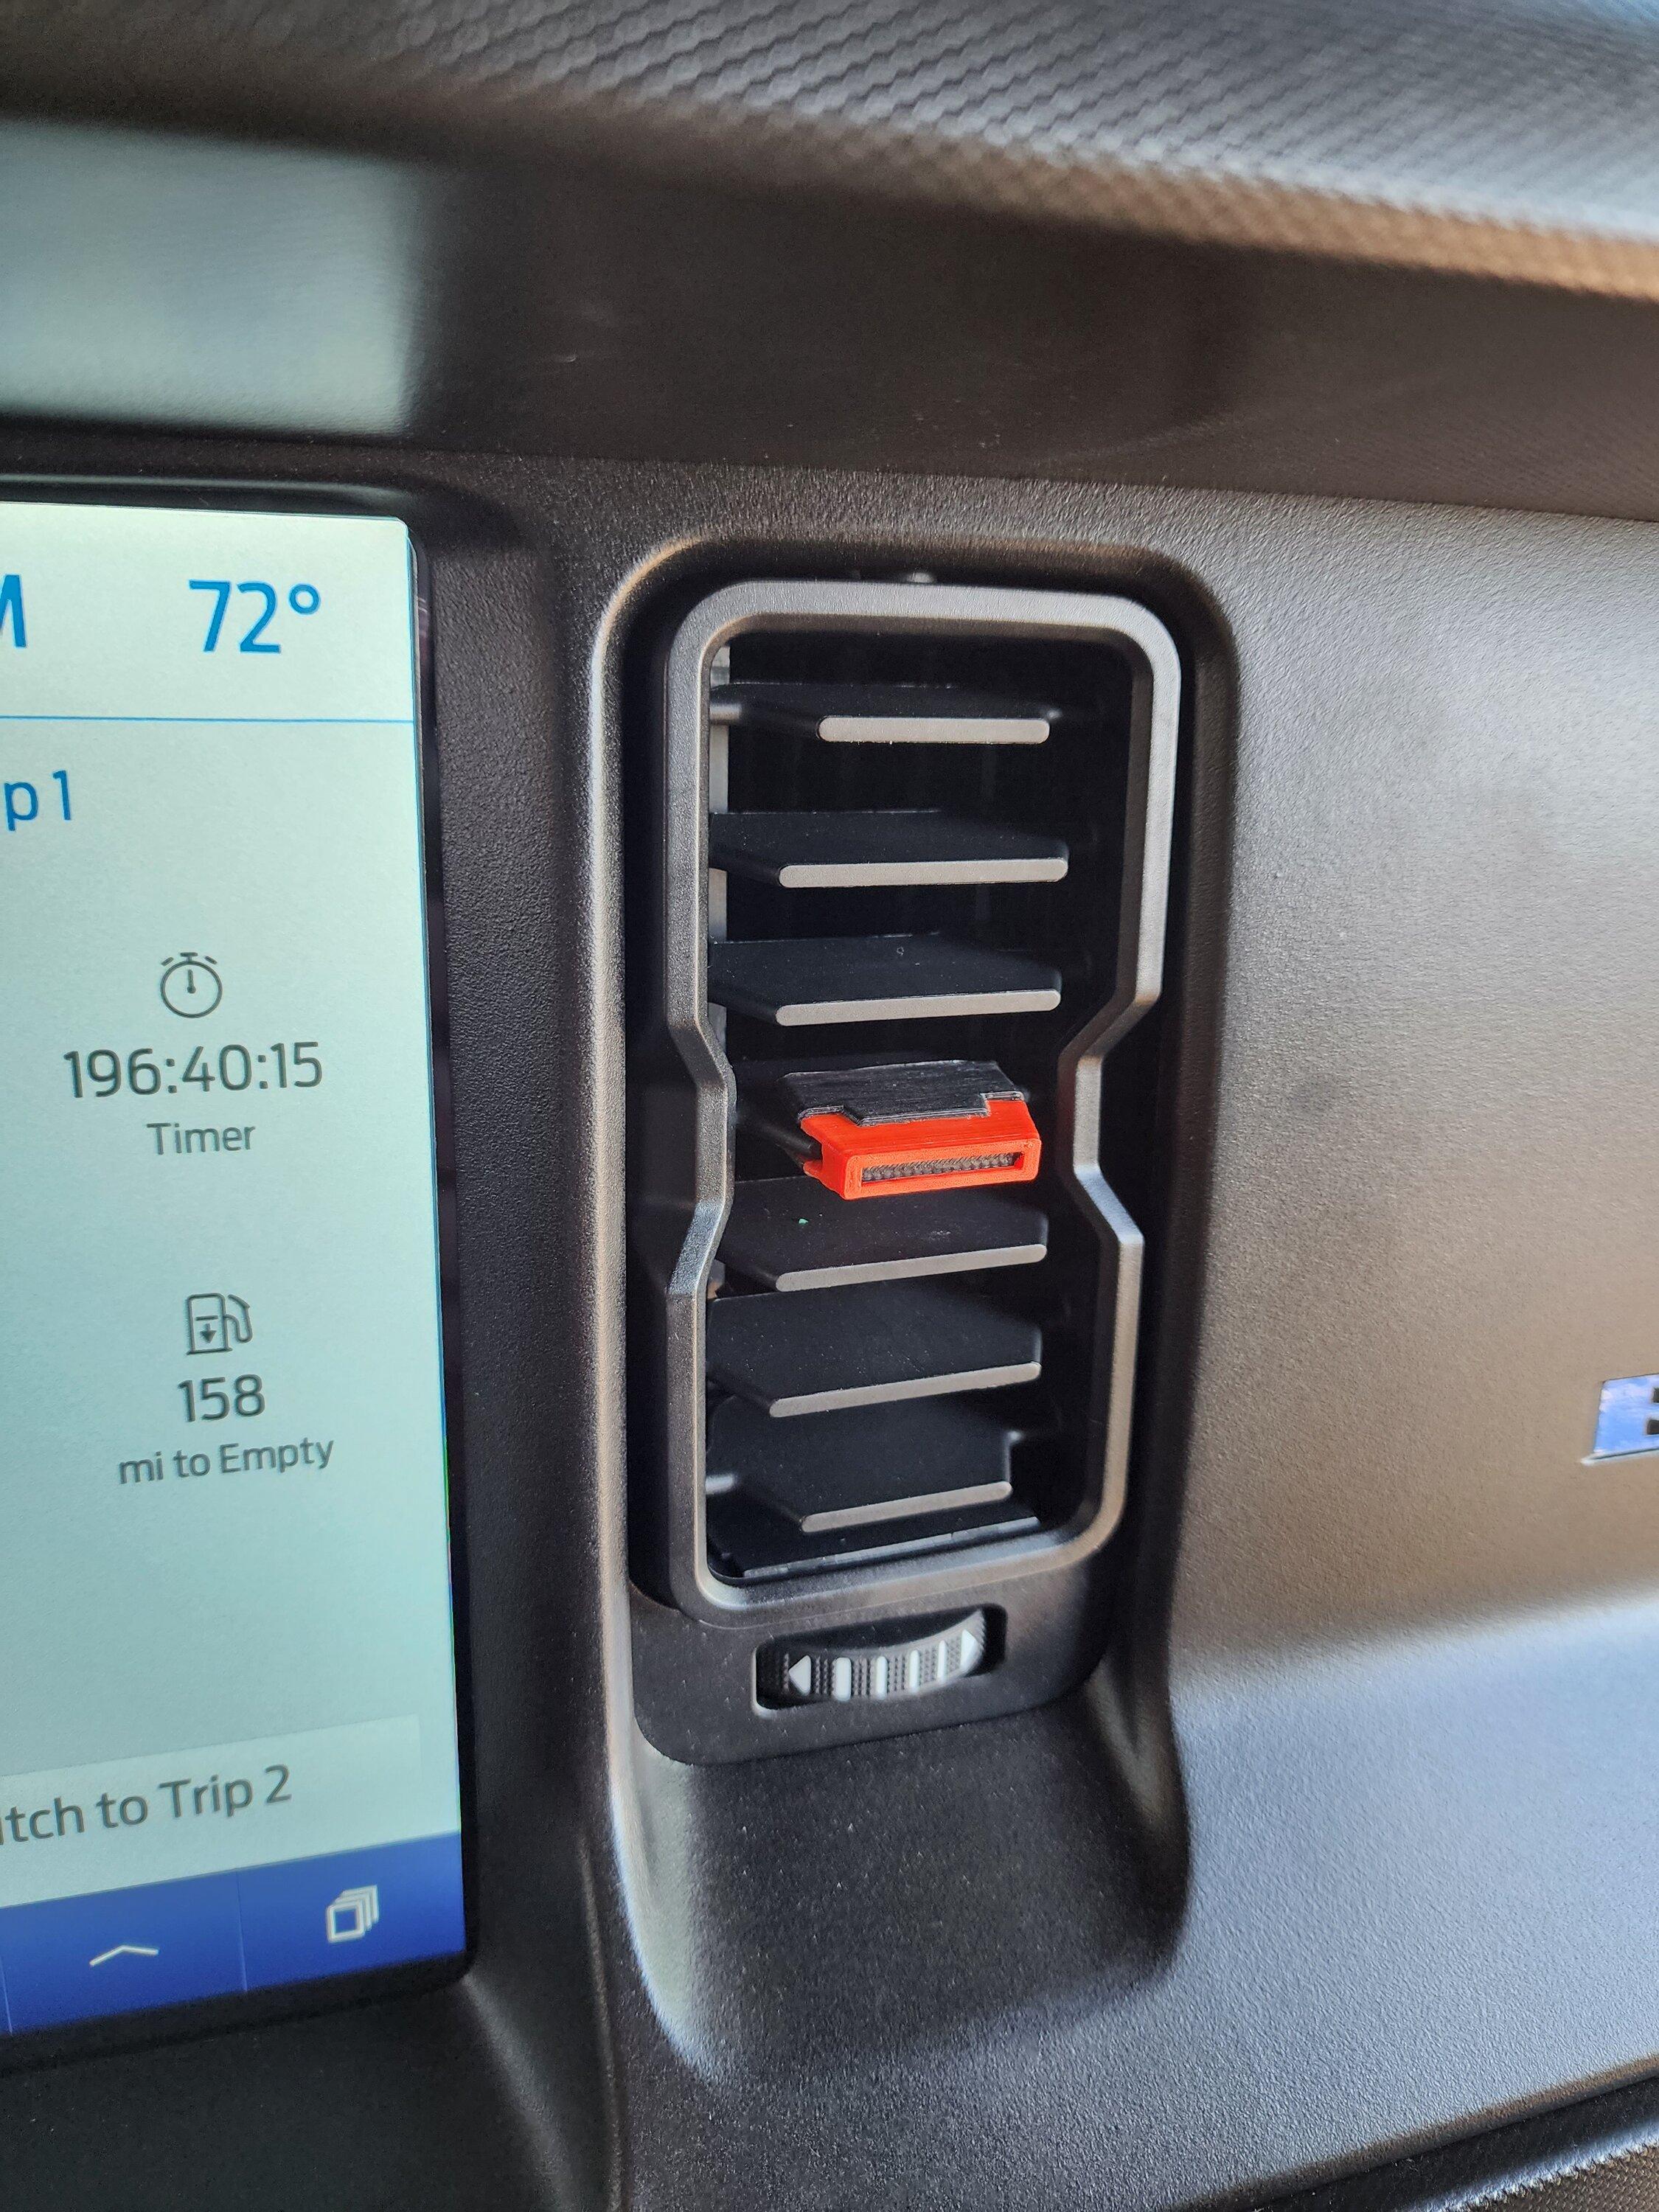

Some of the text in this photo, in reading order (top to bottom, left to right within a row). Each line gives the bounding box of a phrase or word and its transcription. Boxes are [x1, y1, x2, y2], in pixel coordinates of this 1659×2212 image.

[188, 579, 321, 654] 72°
[63, 1041, 323, 1099] 196:40:15
[145, 1122, 256, 1155] Timer
[177, 1374, 265, 1423] 158
[118, 1438, 334, 1485] mi to Empty
[96, 1792, 148, 1829] to
[157, 1773, 253, 1818] Trip
[265, 1764, 293, 1804] 2
